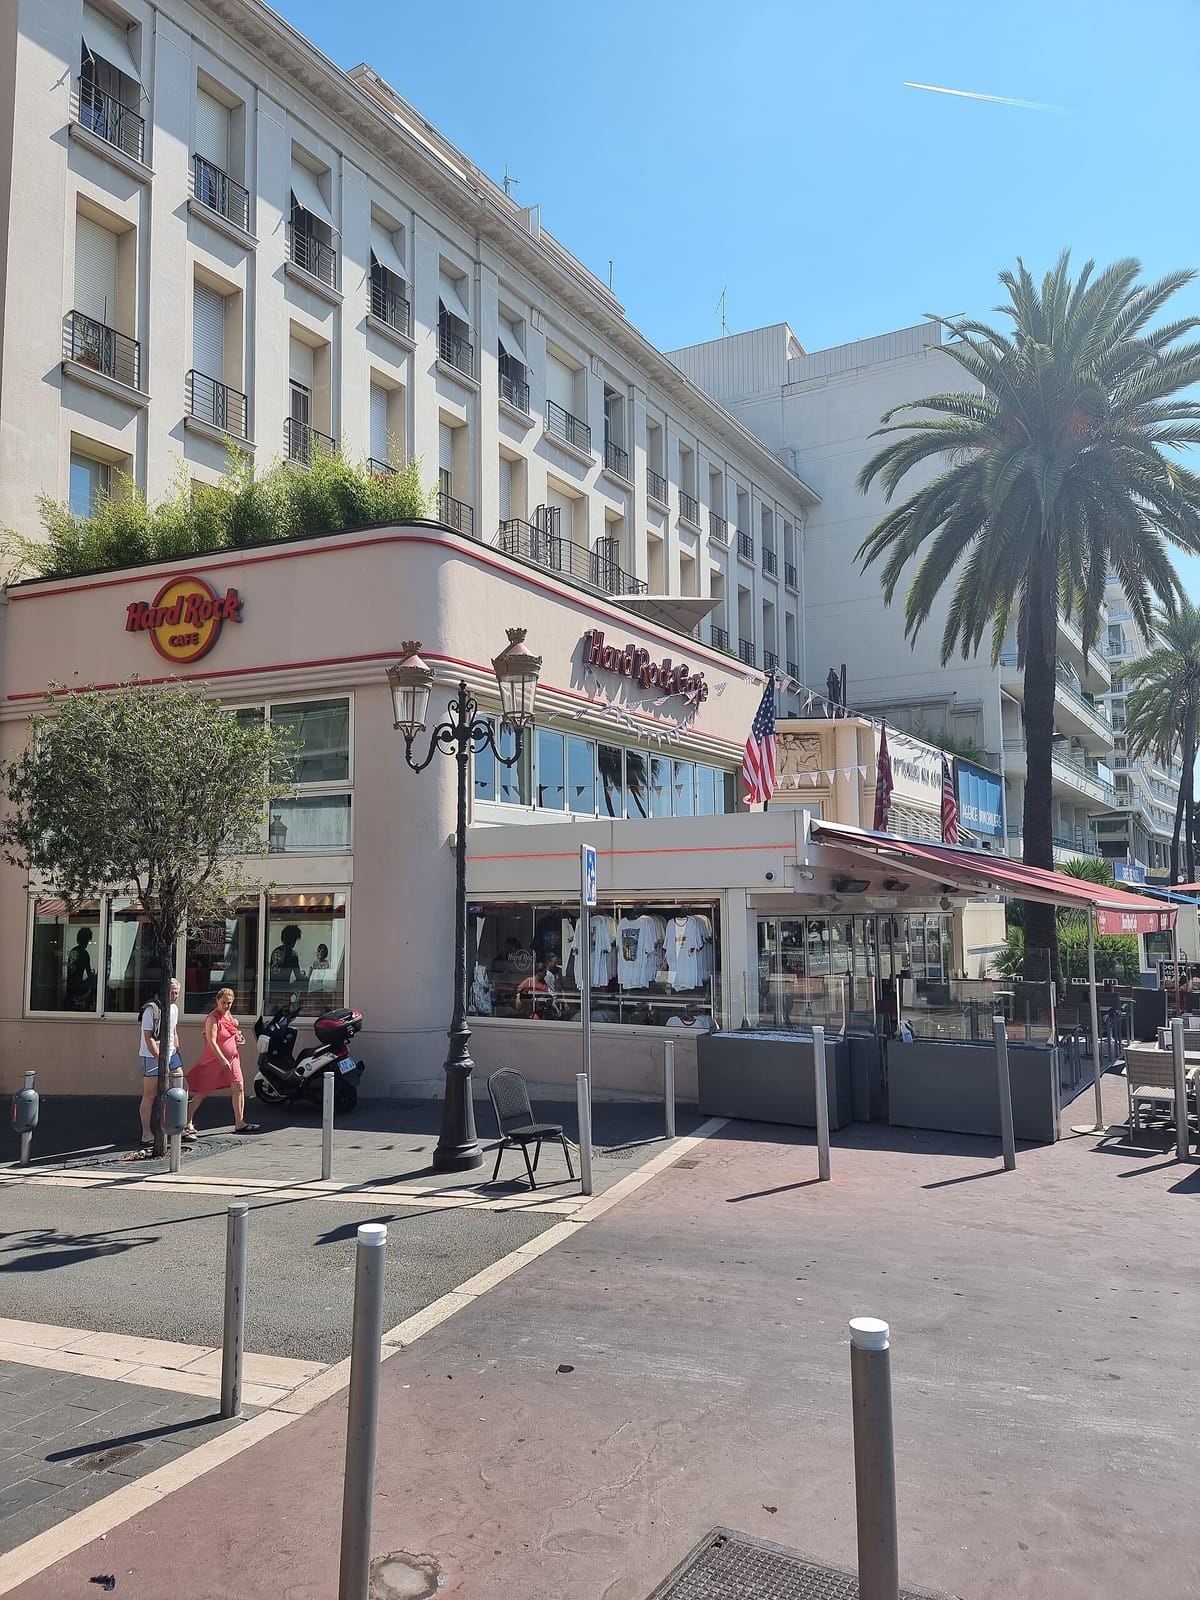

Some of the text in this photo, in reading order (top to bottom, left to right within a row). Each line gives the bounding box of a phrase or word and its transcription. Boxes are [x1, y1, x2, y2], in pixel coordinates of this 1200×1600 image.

[125, 588, 242, 632] Hard Rock
[168, 632, 200, 647] CAFE
[583, 629, 636, 678] Hard
[631, 647, 675, 696] Rock
